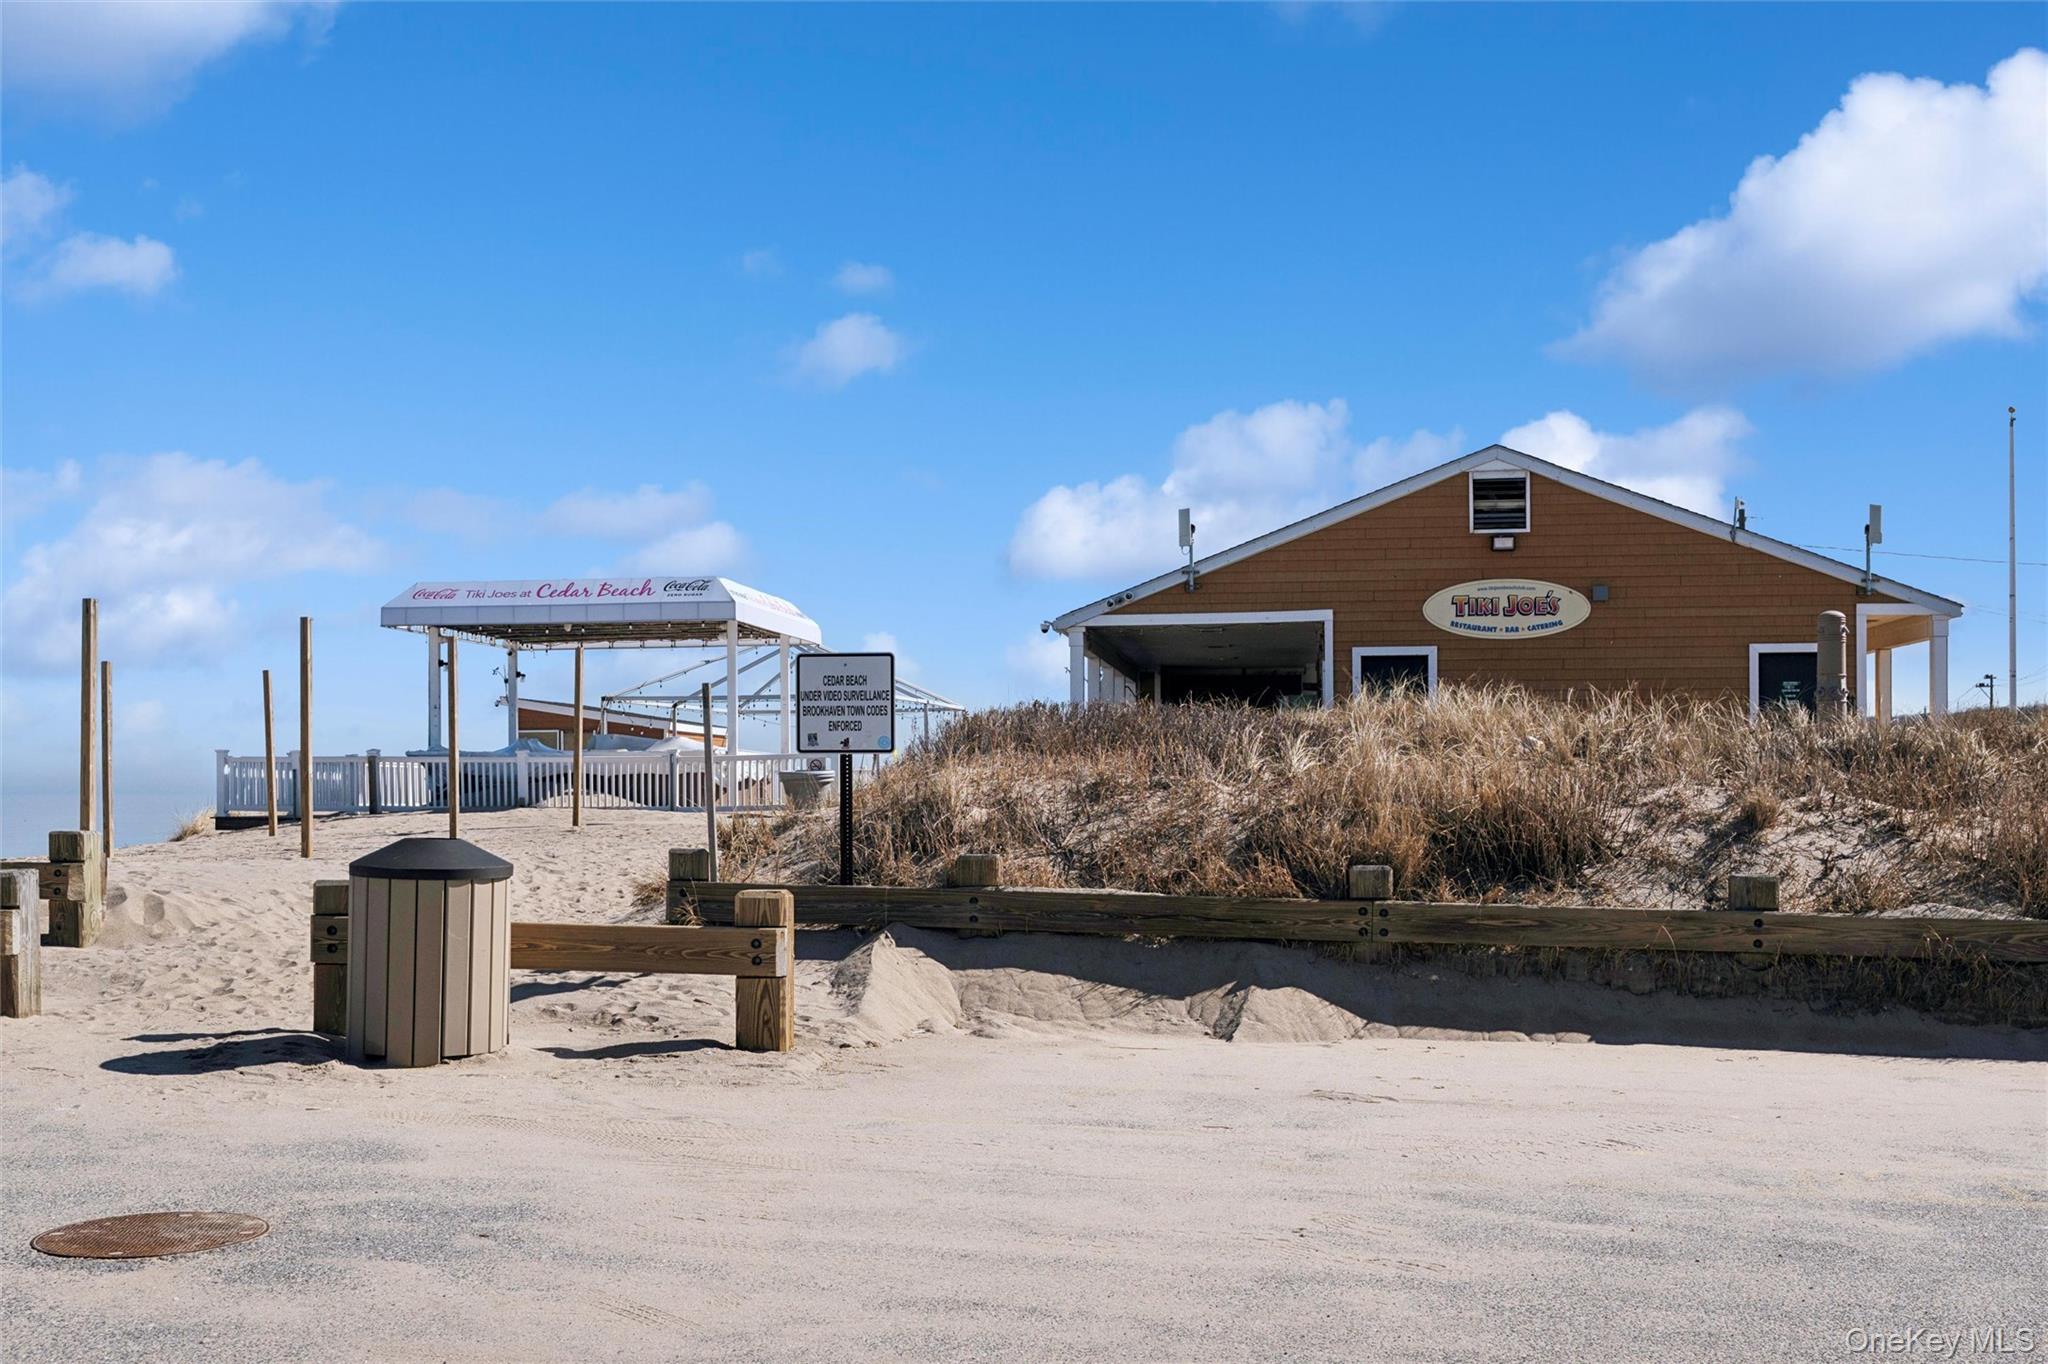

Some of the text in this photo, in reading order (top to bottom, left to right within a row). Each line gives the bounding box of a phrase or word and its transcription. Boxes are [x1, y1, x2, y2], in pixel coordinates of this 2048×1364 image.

[465, 589, 486, 599] Tiki
[487, 589, 517, 599] Joes
[519, 589, 532, 598] at
[536, 581, 592, 599] Cedar
[596, 578, 657, 598] Beach
[1452, 590, 1562, 617] TIKI JOE'S
[1450, 620, 1498, 633] RESTAURANT
[1527, 619, 1564, 632] CATERING
[822, 674, 868, 686] CEDAR BEACH
[800, 689, 890, 701] UNDER VIDEO SURVEILLANCE
[802, 705, 888, 717] BROOKHAVEN TOWN CODES
[828, 720, 863, 732] ENFORCED
